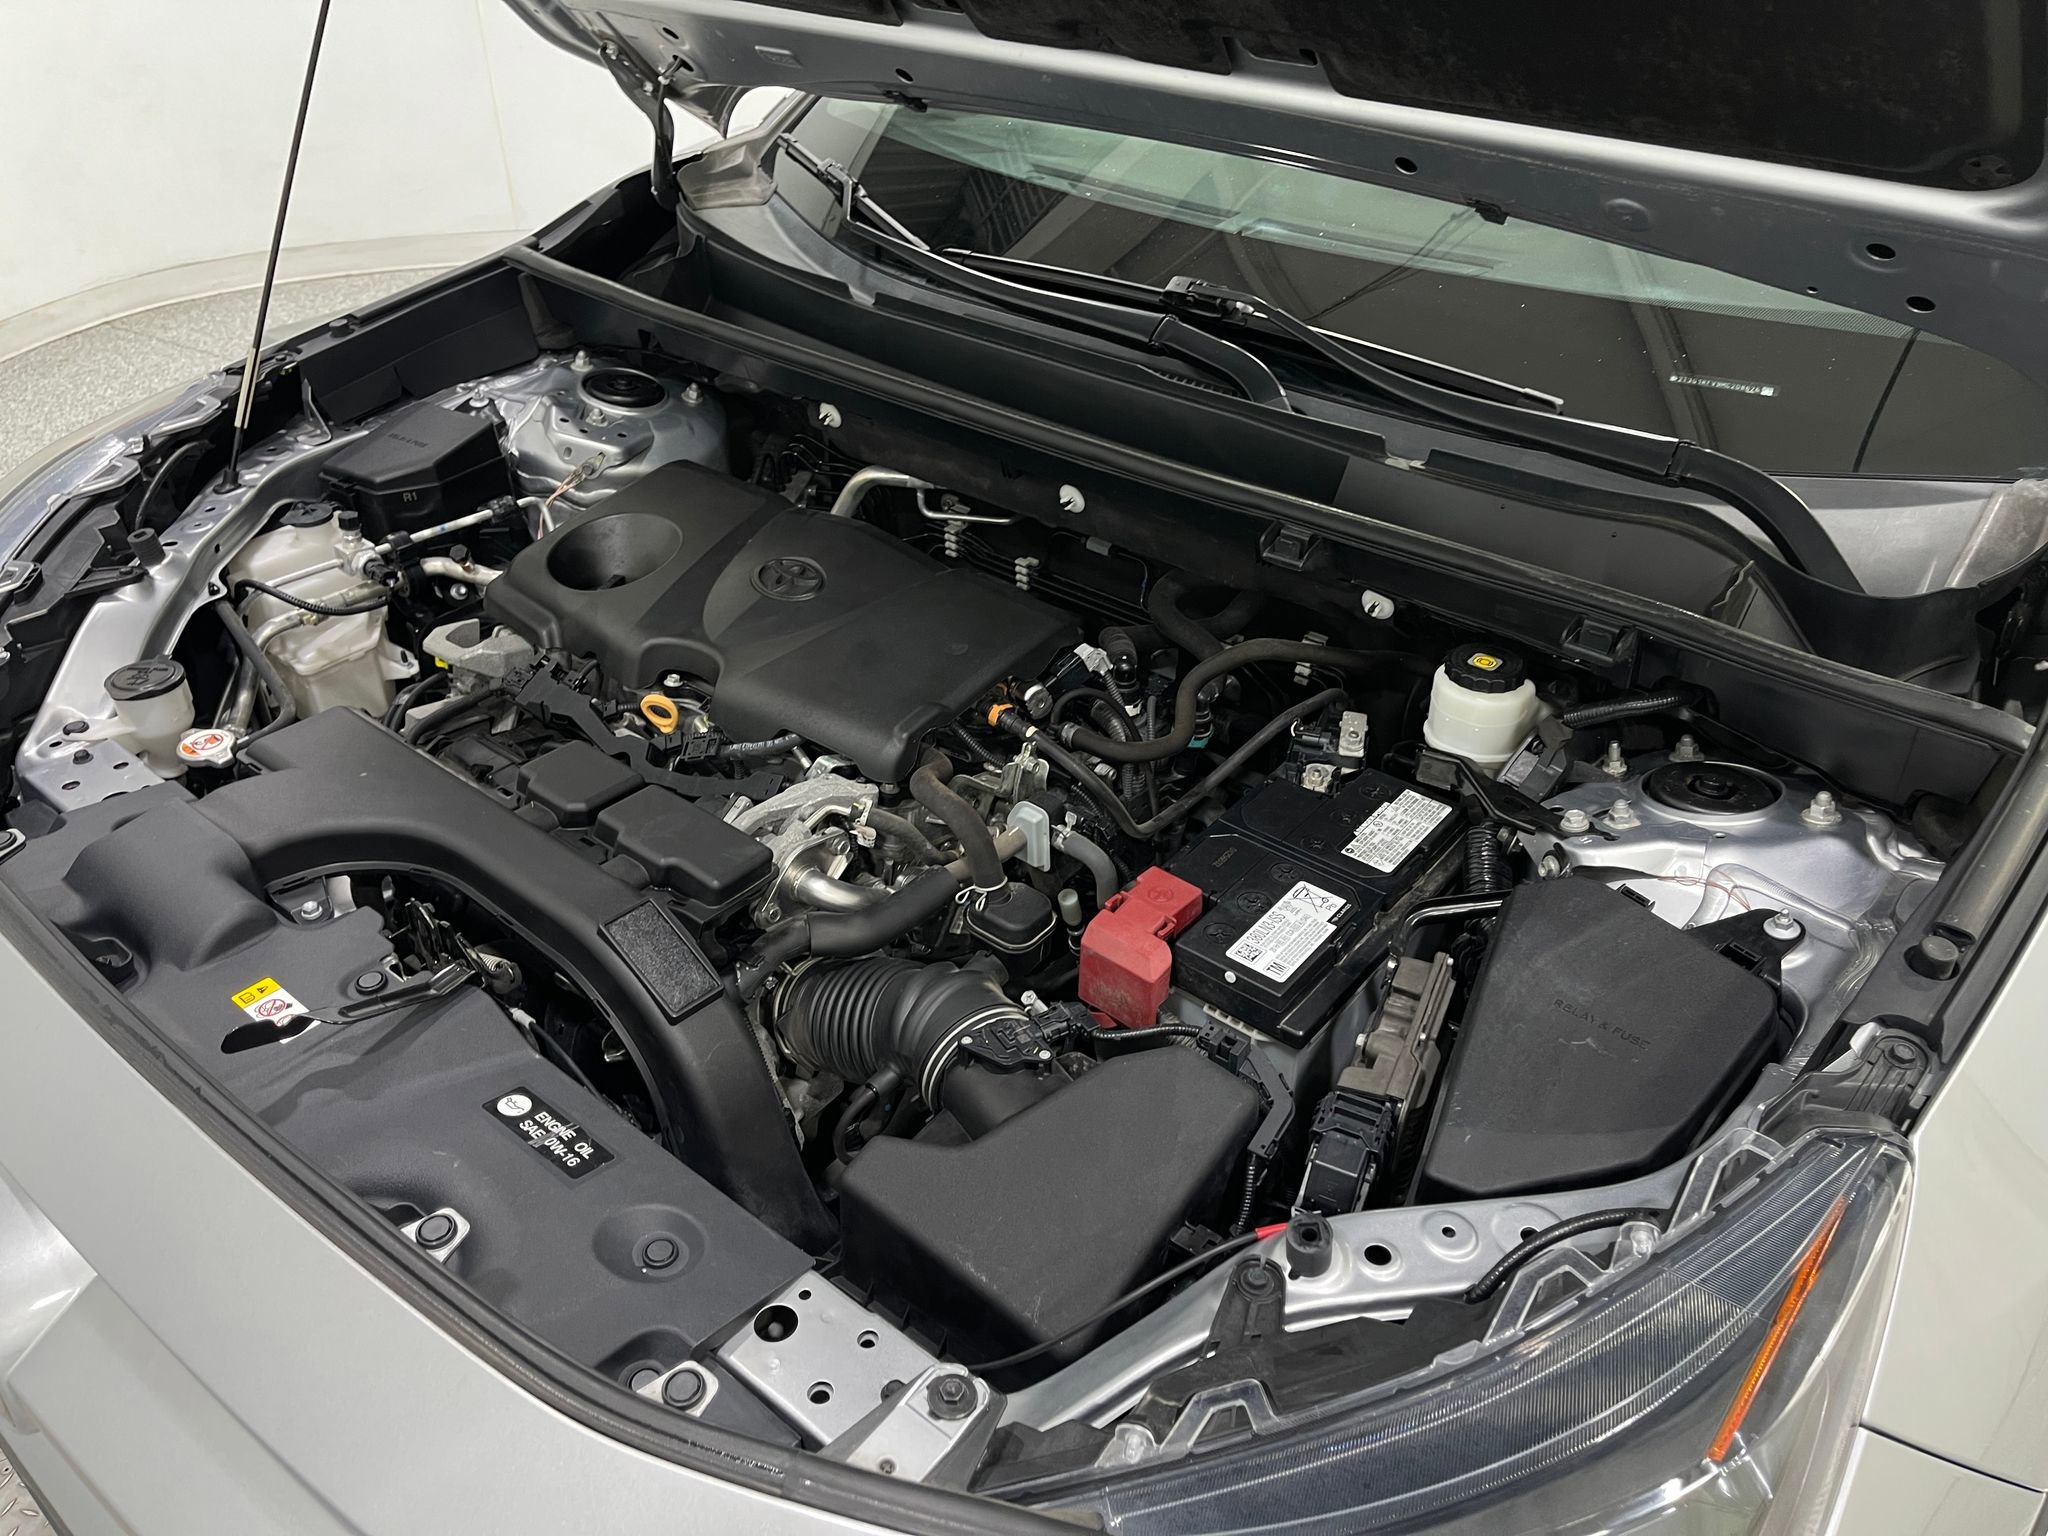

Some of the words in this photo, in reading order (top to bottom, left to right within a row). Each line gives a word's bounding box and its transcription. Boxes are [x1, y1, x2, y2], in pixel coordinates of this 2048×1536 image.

[402, 491, 418, 502] R1
[1266, 961, 1288, 976] TM
[1553, 999, 1595, 1025] RELAY
[1611, 1026, 1651, 1051] FUSE
[519, 1119, 546, 1140] SAE
[544, 1137, 581, 1167] 0W-16
[534, 1111, 576, 1141] ENGINE
[574, 1142, 594, 1160] OIL
